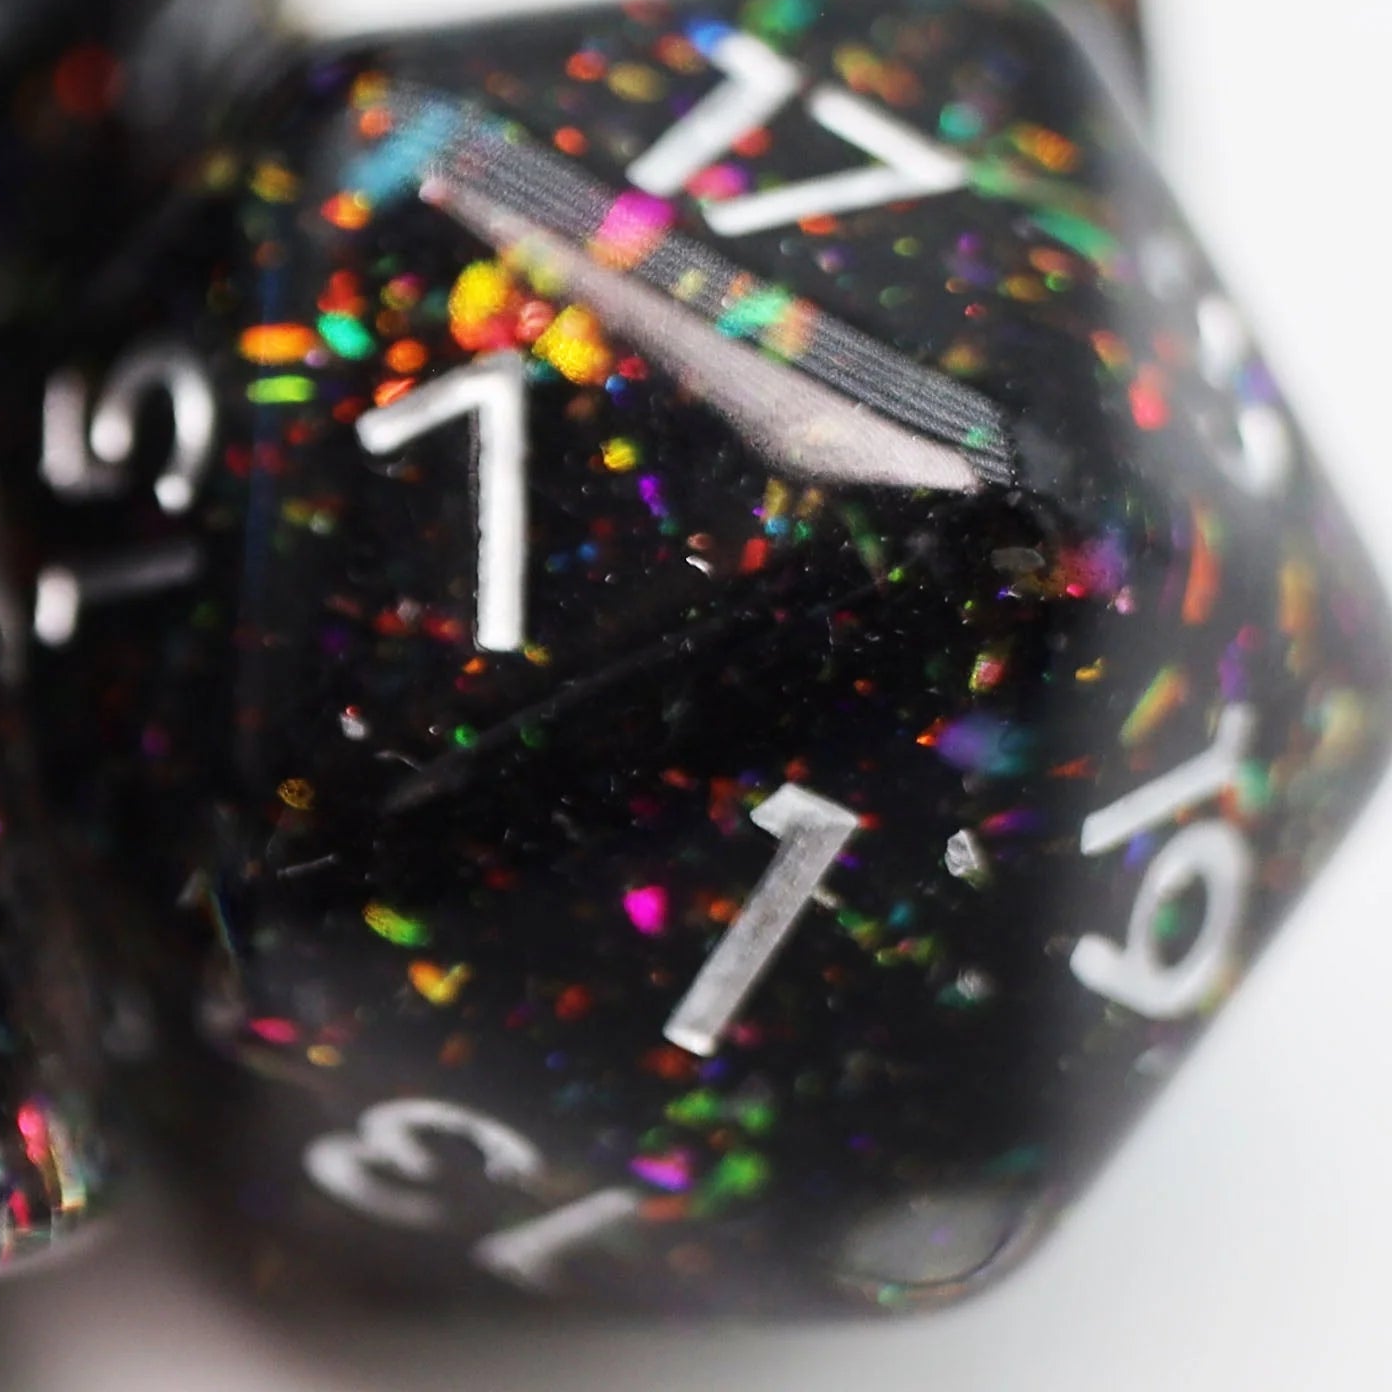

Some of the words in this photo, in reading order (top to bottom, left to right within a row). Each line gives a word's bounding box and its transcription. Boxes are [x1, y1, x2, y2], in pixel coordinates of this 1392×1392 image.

[628, 33, 968, 236] 17
[356, 358, 526, 653] 7
[662, 782, 860, 1058] 1
[1068, 702, 1256, 1020] 19
